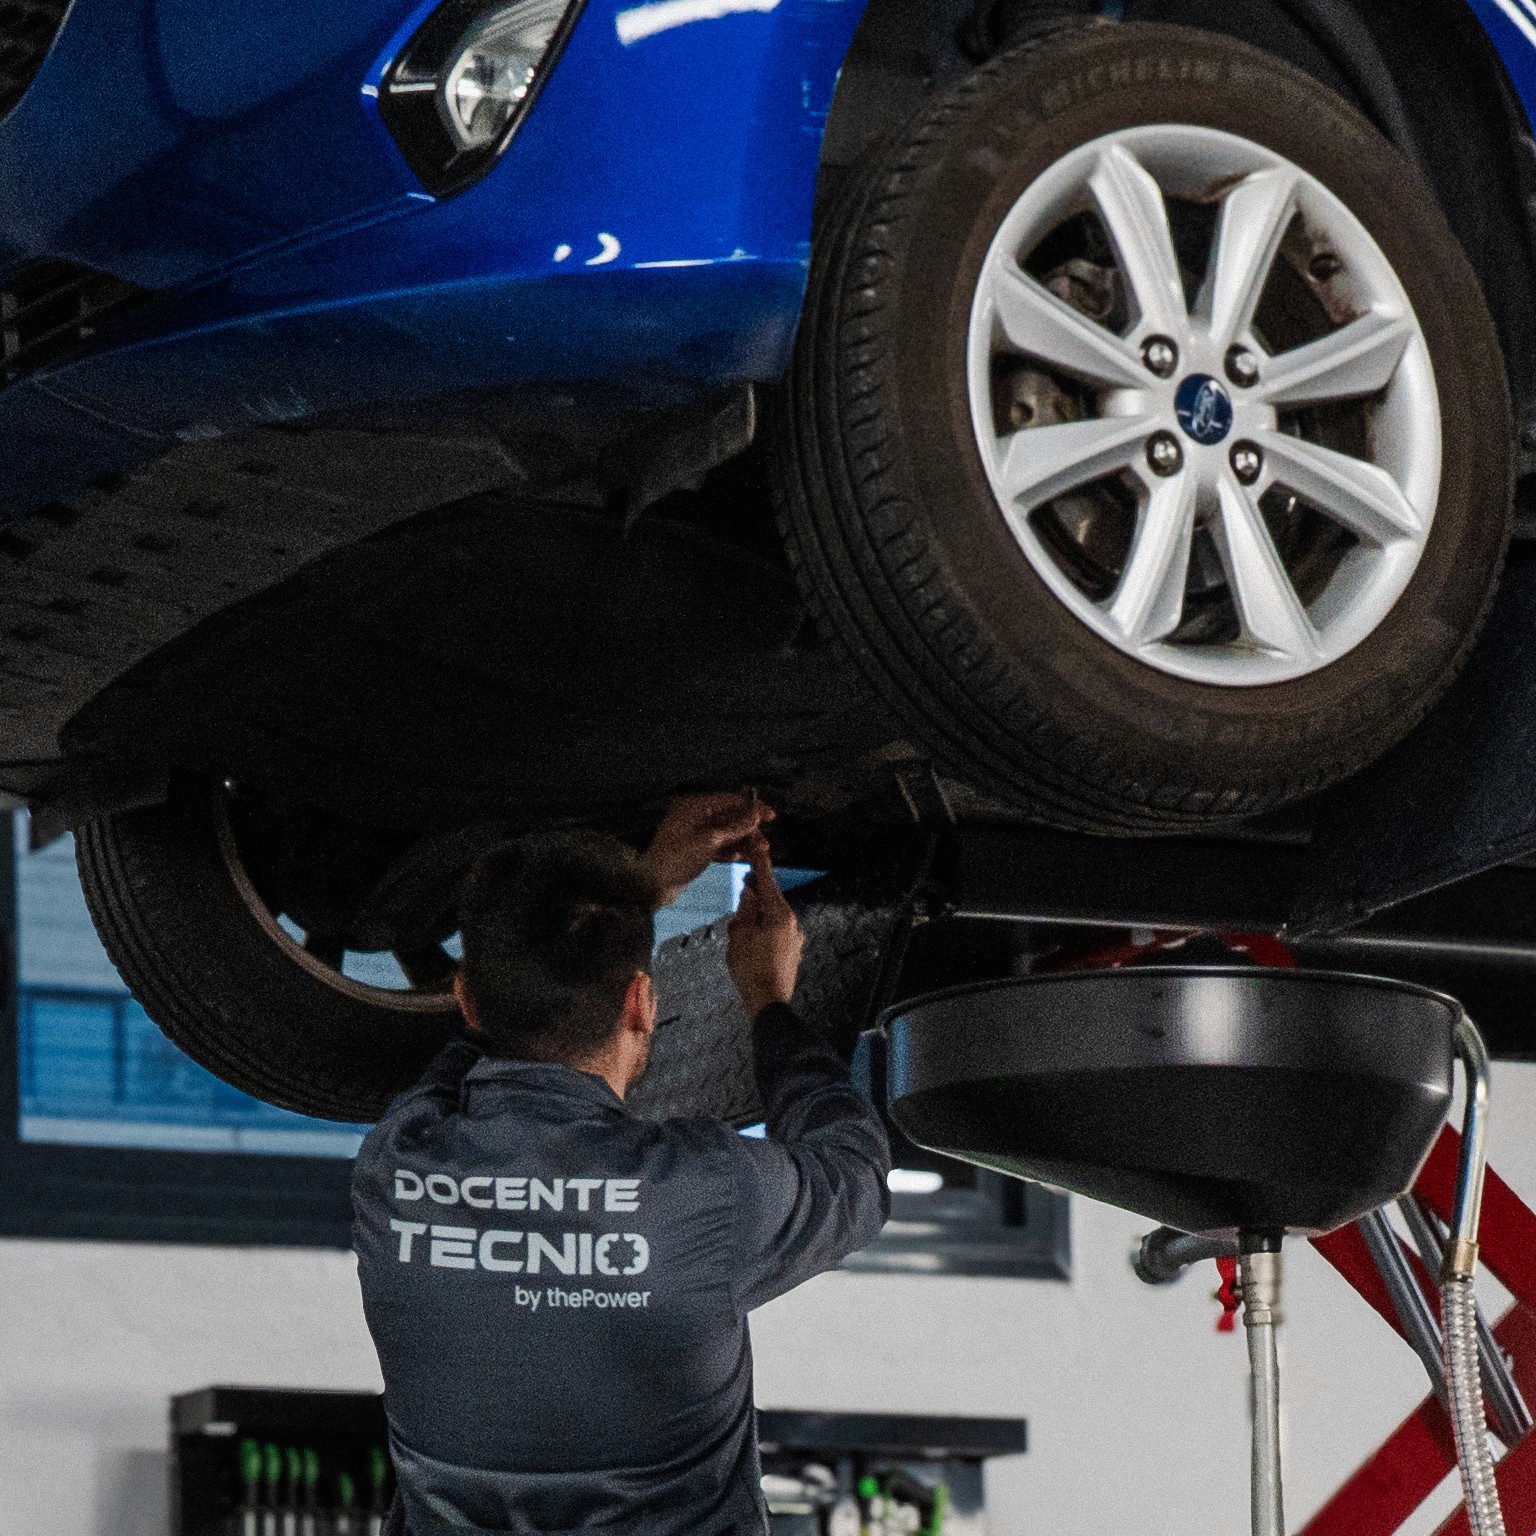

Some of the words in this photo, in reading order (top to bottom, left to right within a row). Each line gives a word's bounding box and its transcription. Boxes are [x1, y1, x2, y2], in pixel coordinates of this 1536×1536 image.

[393, 1169, 642, 1213] DOCENTE
[389, 1218, 650, 1276] TECNIO
[514, 1285, 542, 1312] by
[547, 1287, 651, 1309] thePower
